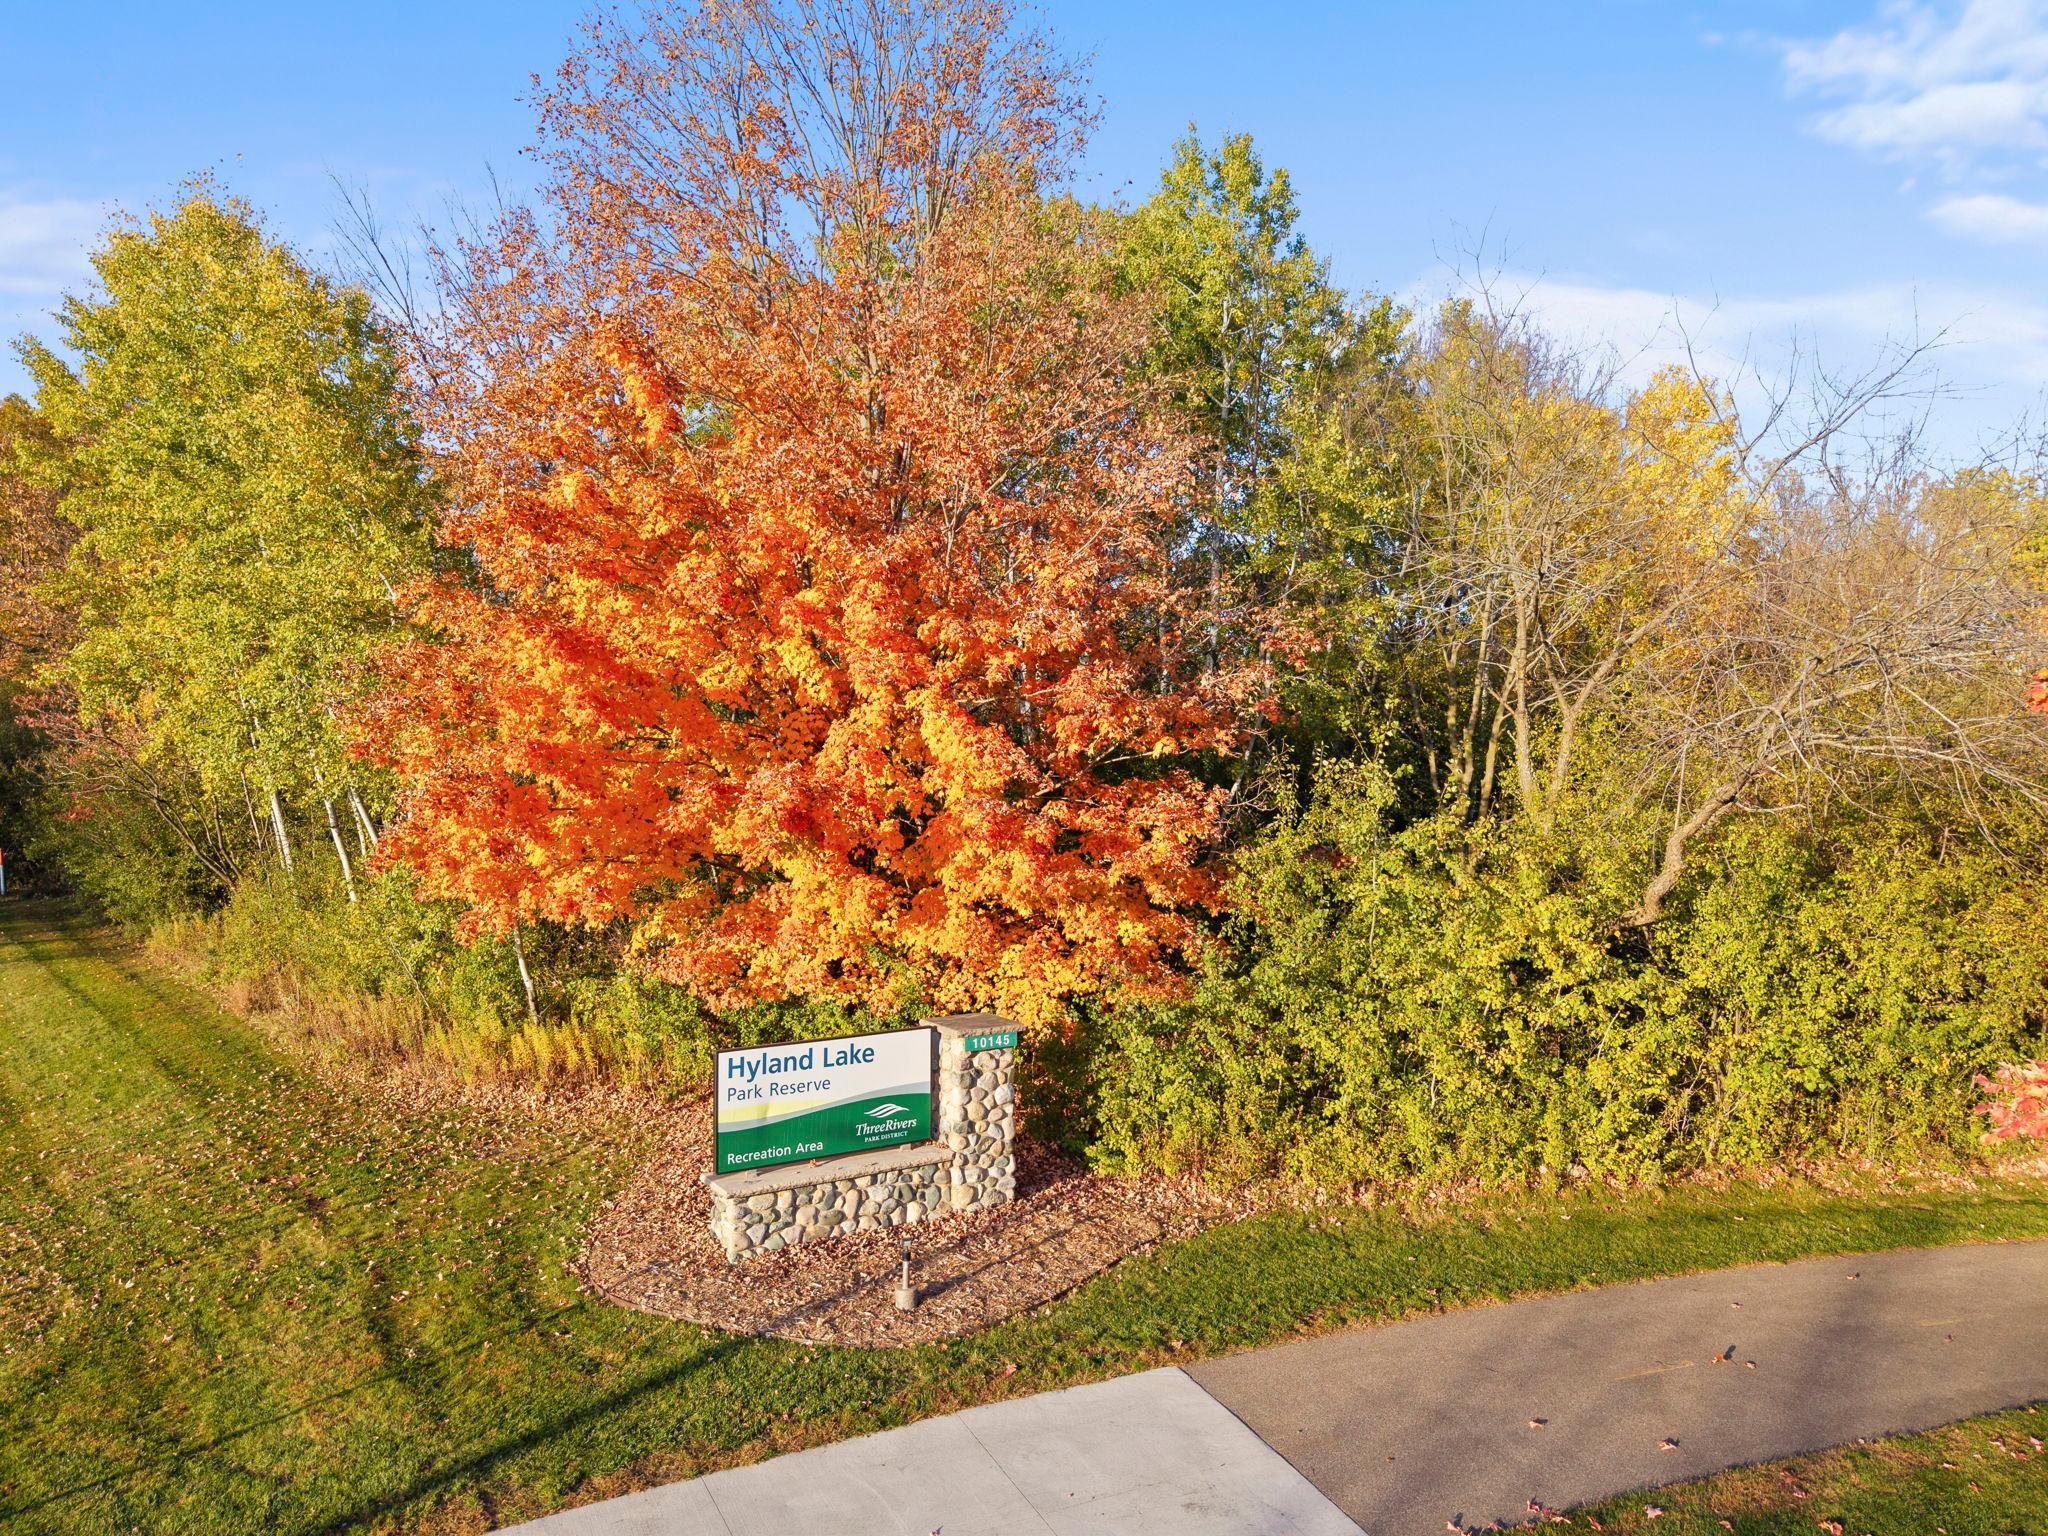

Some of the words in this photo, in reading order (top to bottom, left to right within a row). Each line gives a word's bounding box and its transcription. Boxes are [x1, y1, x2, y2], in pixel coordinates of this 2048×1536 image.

[972, 1034, 1010, 1049] 10145
[727, 1047, 814, 1082] Hyland
[823, 1043, 875, 1068] Lake
[727, 1084, 762, 1102] Park
[769, 1077, 831, 1097] Reserve
[881, 1131, 908, 1140] DISTRICT
[727, 1143, 792, 1164] Recreation
[795, 1140, 824, 1153] Area
